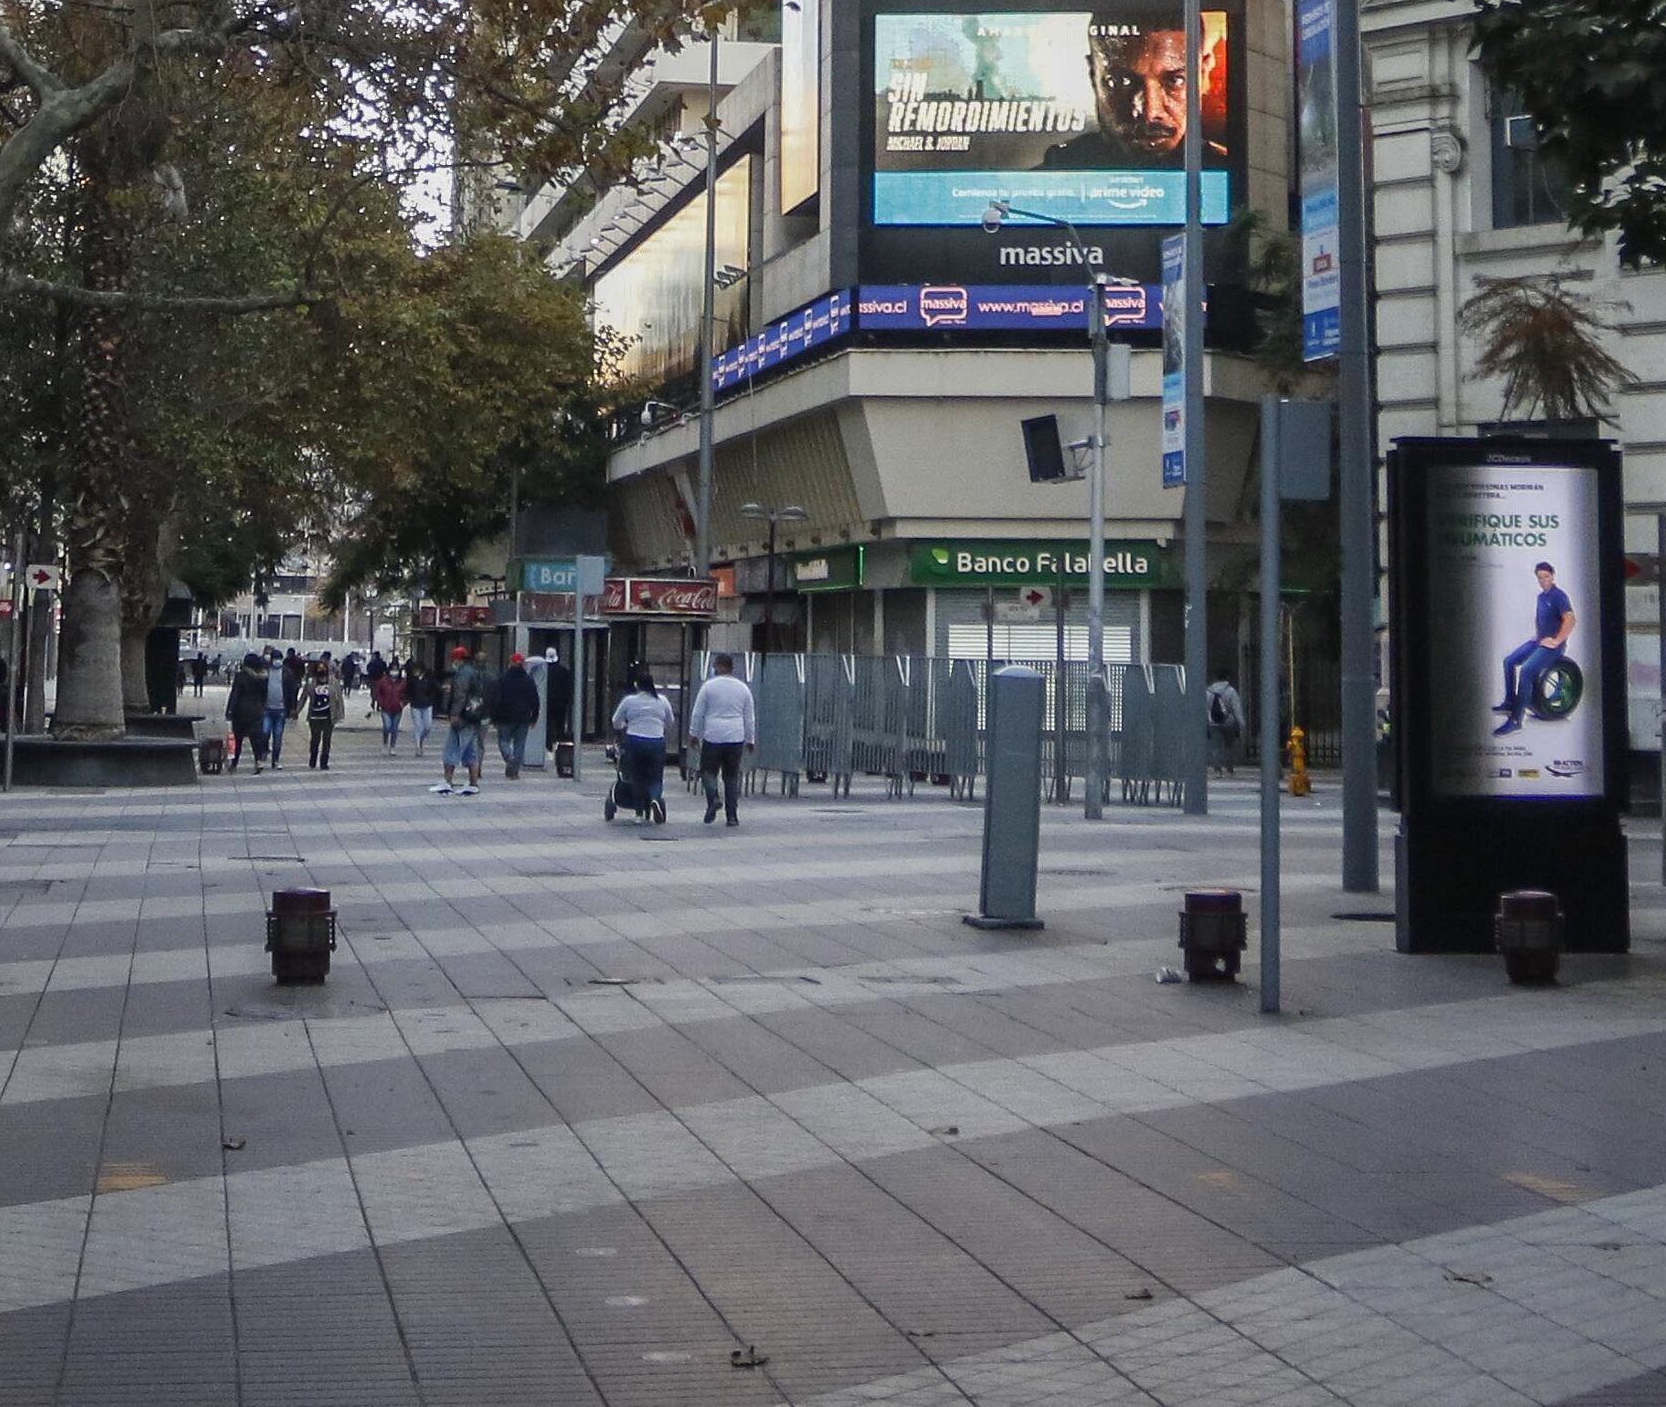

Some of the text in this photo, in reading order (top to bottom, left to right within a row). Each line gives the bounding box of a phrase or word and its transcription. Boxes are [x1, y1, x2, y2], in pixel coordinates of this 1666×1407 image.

[887, 72, 929, 103] SIN
[887, 100, 1087, 133] REMORDIMIENTOS
[1129, 185, 1165, 199] video
[1000, 240, 1104, 266] massiva
[921, 297, 968, 310] massiva
[978, 299, 1085, 316] www.massiva.cl
[1528, 514, 1560, 529] SUS
[1445, 529, 1548, 548] UMÁTICOS
[956, 552, 1149, 574] Banco Flaella
